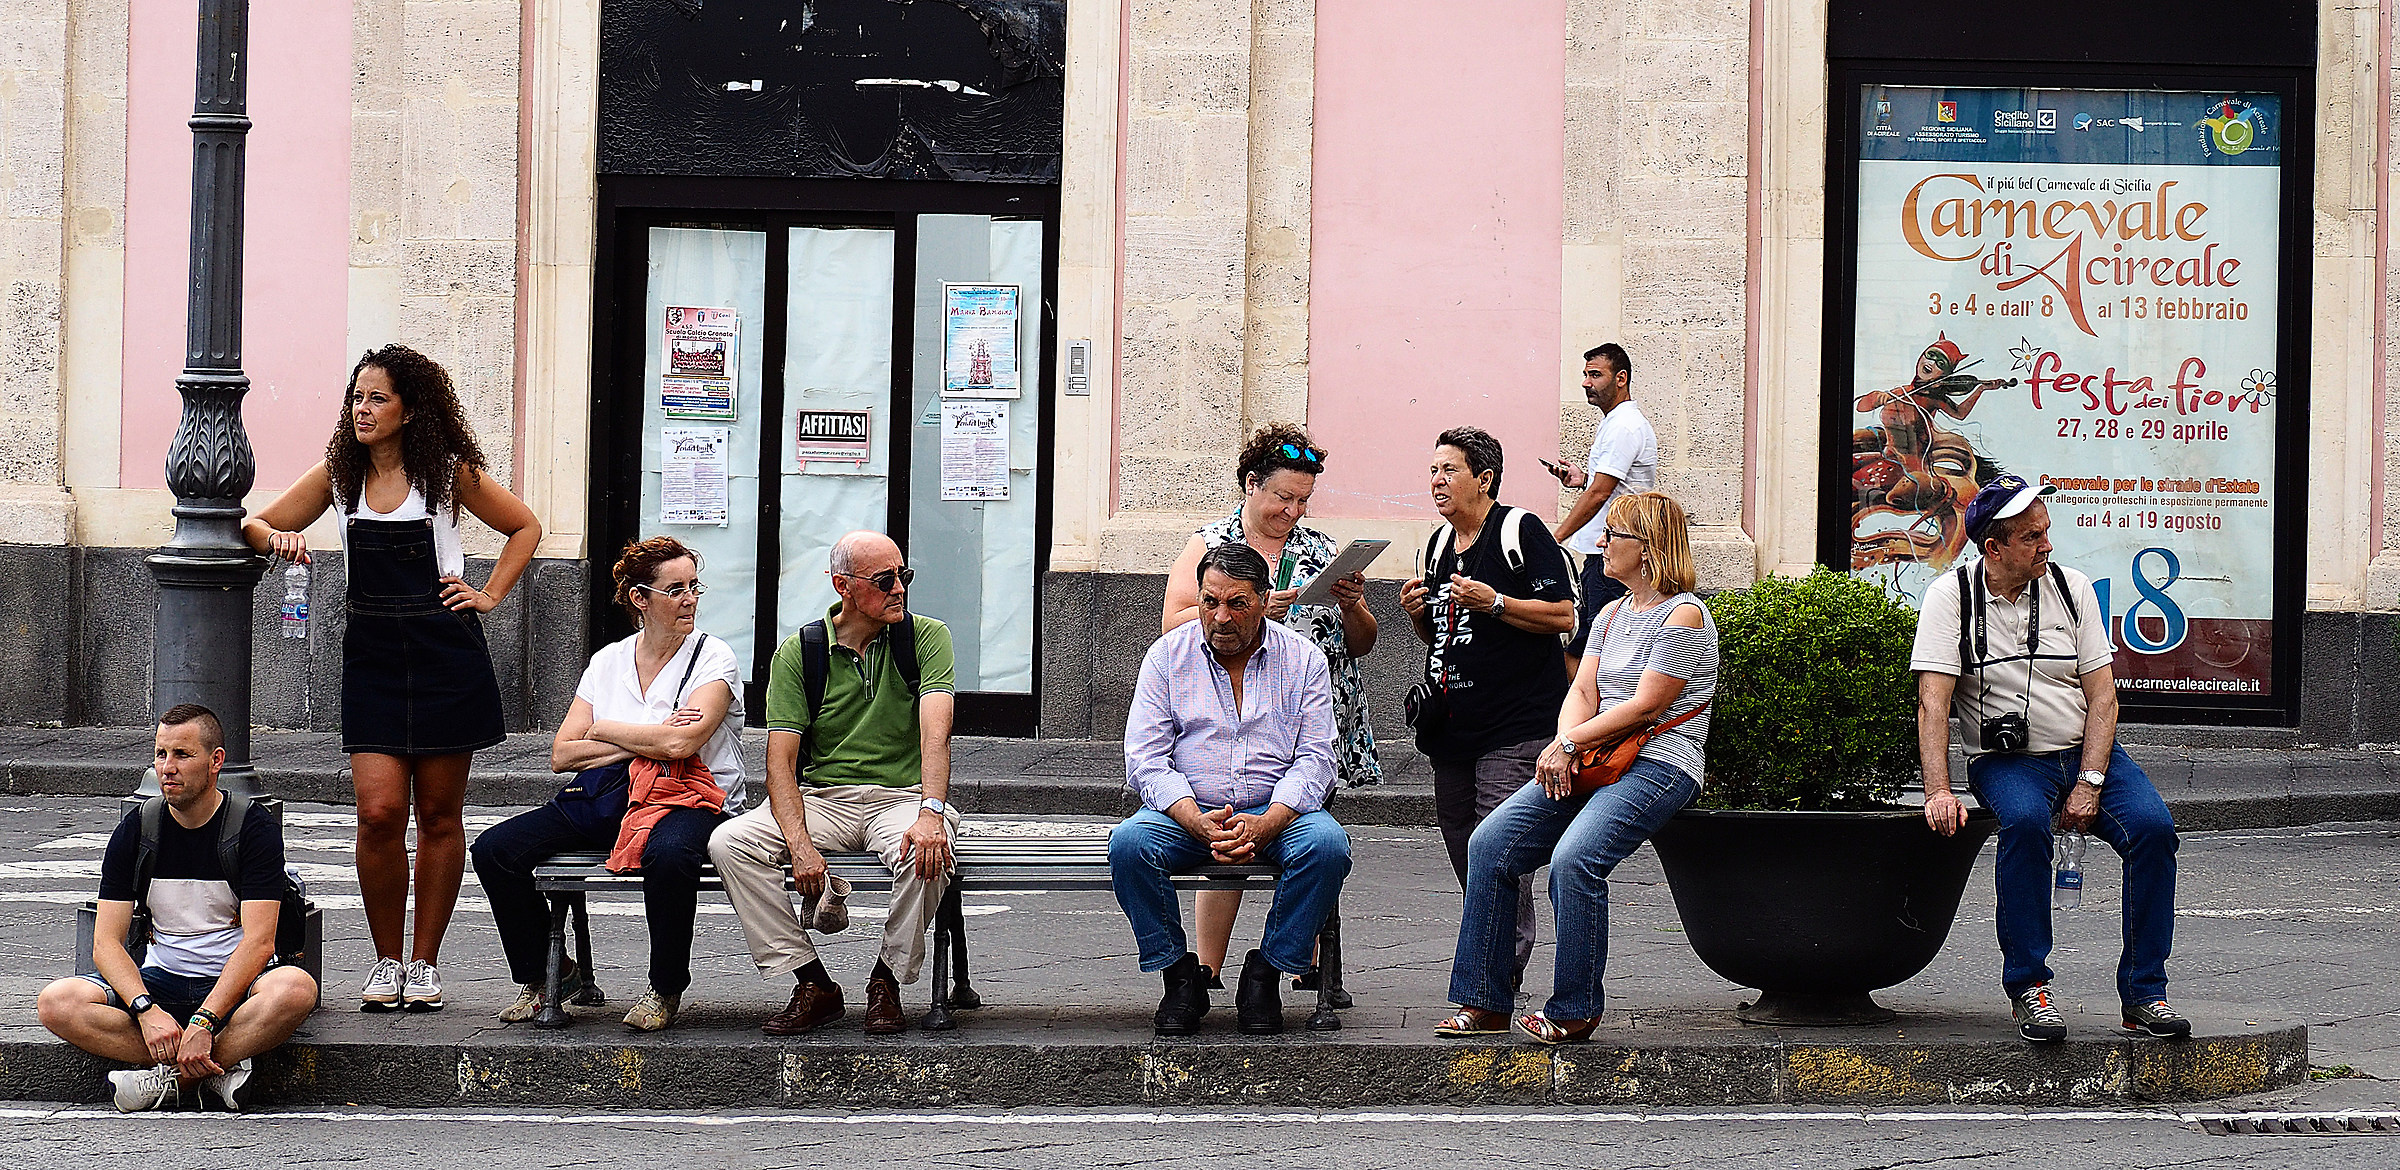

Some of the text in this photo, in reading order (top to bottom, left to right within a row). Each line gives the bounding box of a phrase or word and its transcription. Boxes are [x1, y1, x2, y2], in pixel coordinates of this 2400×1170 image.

[1994, 110, 2029, 120] Credito
[1994, 119, 2034, 127] Siciliano
[2096, 119, 2115, 127] SAC
[2206, 98, 2242, 115] Carnevale
[2243, 101, 2252, 109] di
[2251, 107, 2269, 135] Acireale
[1987, 176, 1995, 189] il
[2018, 177, 2034, 190] bel
[2037, 178, 2096, 193] Carnevale
[2100, 178, 2110, 191] di
[2112, 178, 2152, 195] Sicilia
[1901, 173, 2209, 262] Carnevale
[1979, 230, 2242, 338] di Acireale
[1928, 292, 1942, 316] 3
[1950, 302, 1959, 315] e
[1965, 293, 1978, 316] 4
[1986, 302, 1995, 315] e
[2041, 295, 2054, 317] 8
[2098, 303, 2112, 318] al
[2121, 295, 2148, 319] 13
[2156, 297, 2249, 320] febbraio
[2023, 351, 2260, 416] festa dei fiori
[801, 414, 866, 436] AFFITTASI
[2056, 418, 2229, 445] 27, 28 e 29 aprile
[2039, 473, 2260, 494] Carnevale per le strade d'Estate
[2055, 494, 2100, 505] allegorico
[2102, 495, 2147, 507] grotteschi
[2149, 496, 2158, 505] in
[2160, 497, 2212, 508] esposizione
[2215, 499, 2268, 509] permanente
[2076, 511, 2222, 533] dal 4 al 19 agosto
[1448, 664, 1456, 672] OF
[1447, 680, 1474, 689] WORLD
